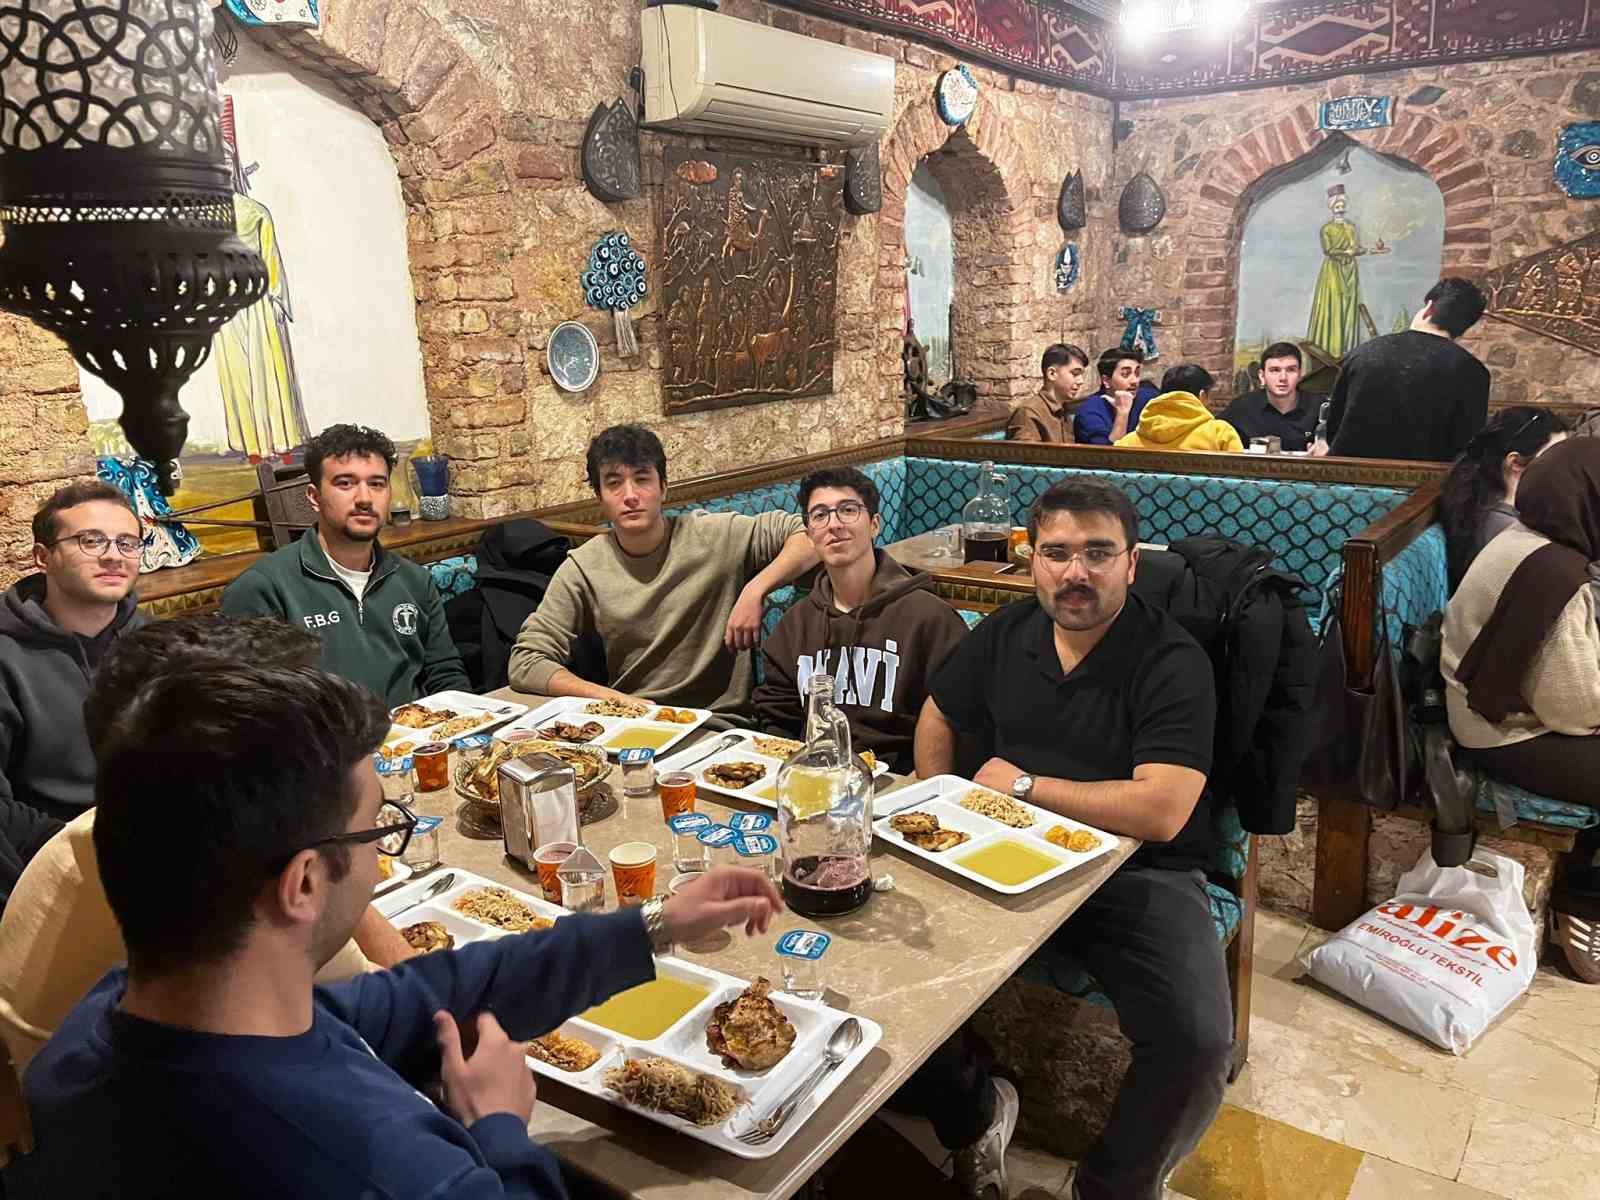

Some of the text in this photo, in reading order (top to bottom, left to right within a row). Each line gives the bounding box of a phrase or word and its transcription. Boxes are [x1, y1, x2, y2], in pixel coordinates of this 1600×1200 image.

[303, 610, 341, 629] F.B.G
[1376, 903, 1518, 972] alize
[1430, 951, 1485, 988] TEKSTİL
